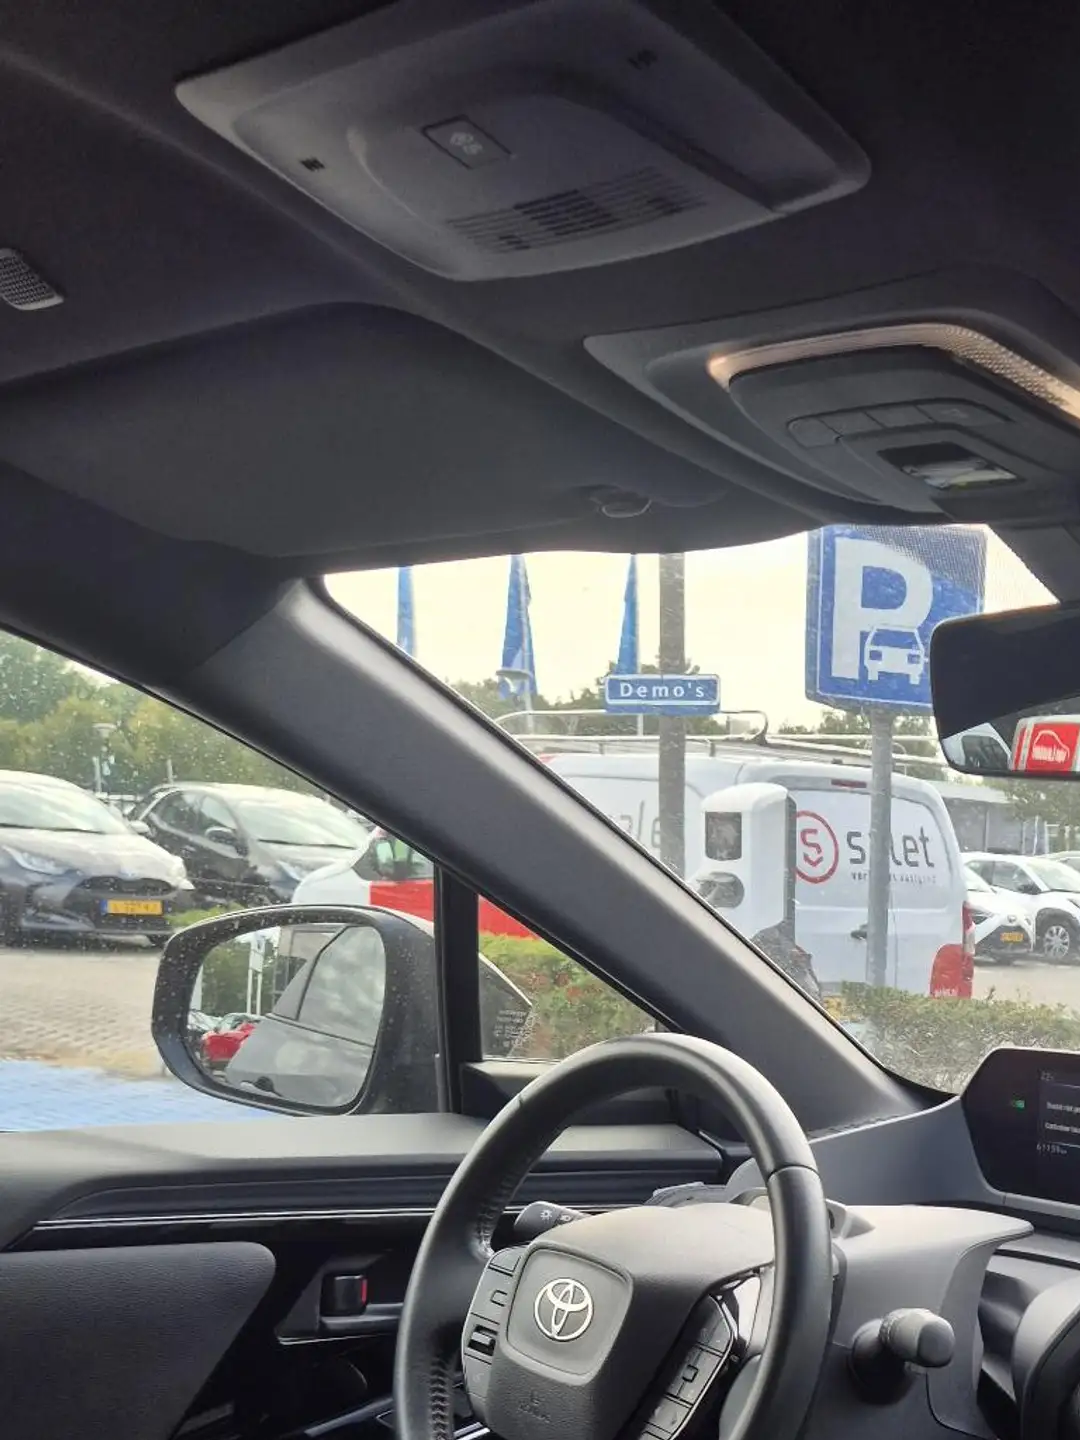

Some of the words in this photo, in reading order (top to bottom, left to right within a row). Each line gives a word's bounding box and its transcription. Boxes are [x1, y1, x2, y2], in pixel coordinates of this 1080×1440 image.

[831, 536, 934, 680] P
[620, 682, 705, 698] Demo's
[846, 826, 935, 867] slet
